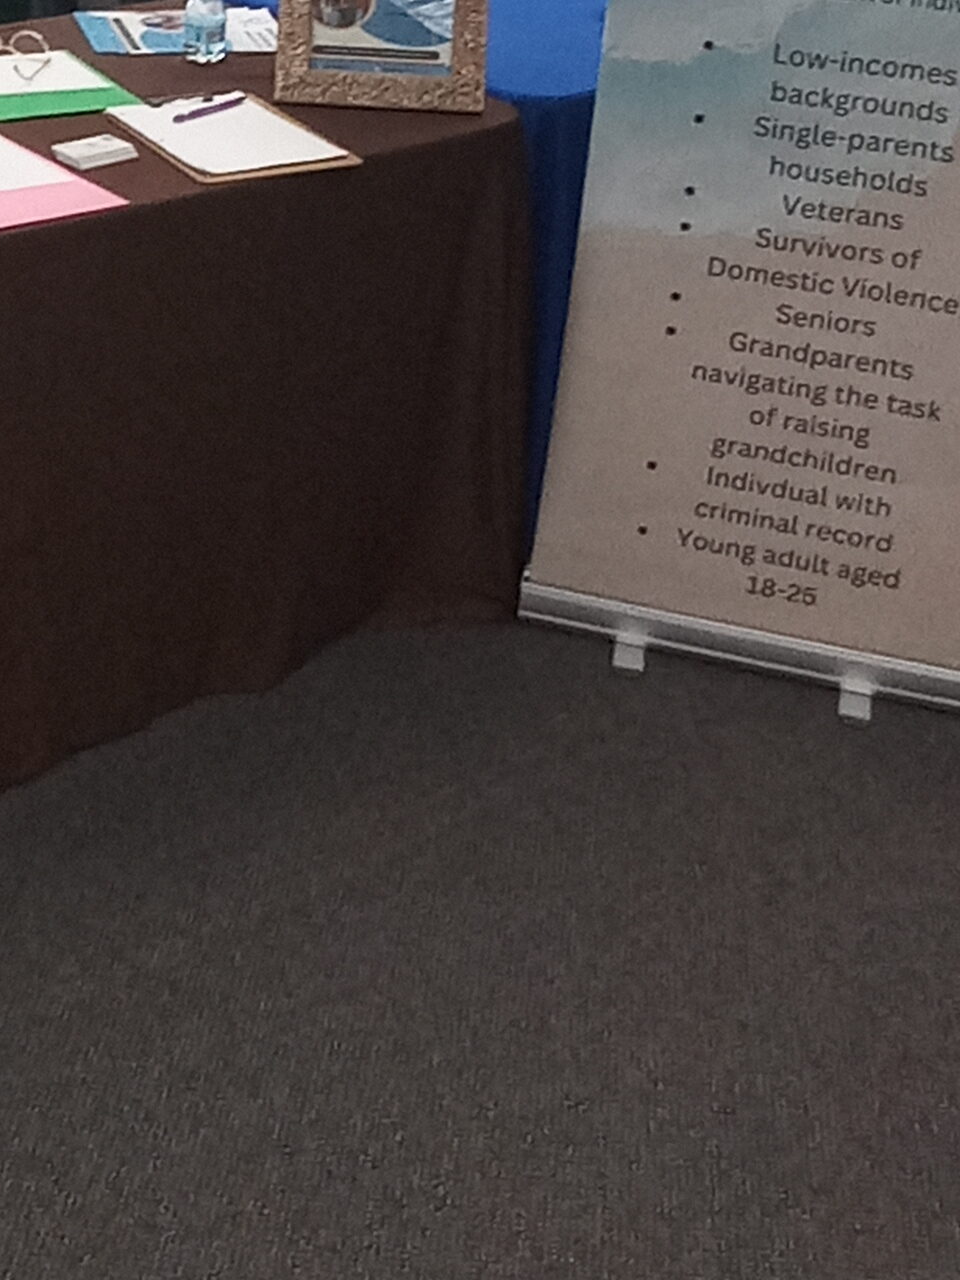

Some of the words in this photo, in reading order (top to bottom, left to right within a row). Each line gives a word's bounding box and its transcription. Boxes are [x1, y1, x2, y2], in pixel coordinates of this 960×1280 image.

[772, 43, 958, 87] Low-incomes
[770, 80, 949, 124] backgrounds
[753, 115, 955, 163] Single-parents
[769, 155, 928, 197] households
[783, 194, 904, 230] Veterans
[755, 227, 884, 264] Survivors
[891, 249, 922, 270] of
[707, 256, 835, 295] Domestic
[841, 275, 959, 315] Violence
[775, 303, 877, 337] Seniors
[728, 331, 914, 380] Grandparents
[691, 363, 828, 407] navigating
[835, 385, 879, 410] the
[886, 394, 941, 422] task
[749, 407, 778, 427] of
[782, 414, 871, 449] raising
[710, 436, 897, 485] grandchildren
[694, 500, 799, 536] criminal
[805, 520, 894, 554] record
[835, 492, 892, 518] with
[677, 526, 756, 566] Young
[762, 546, 829, 577] adult
[837, 560, 902, 590] aged
